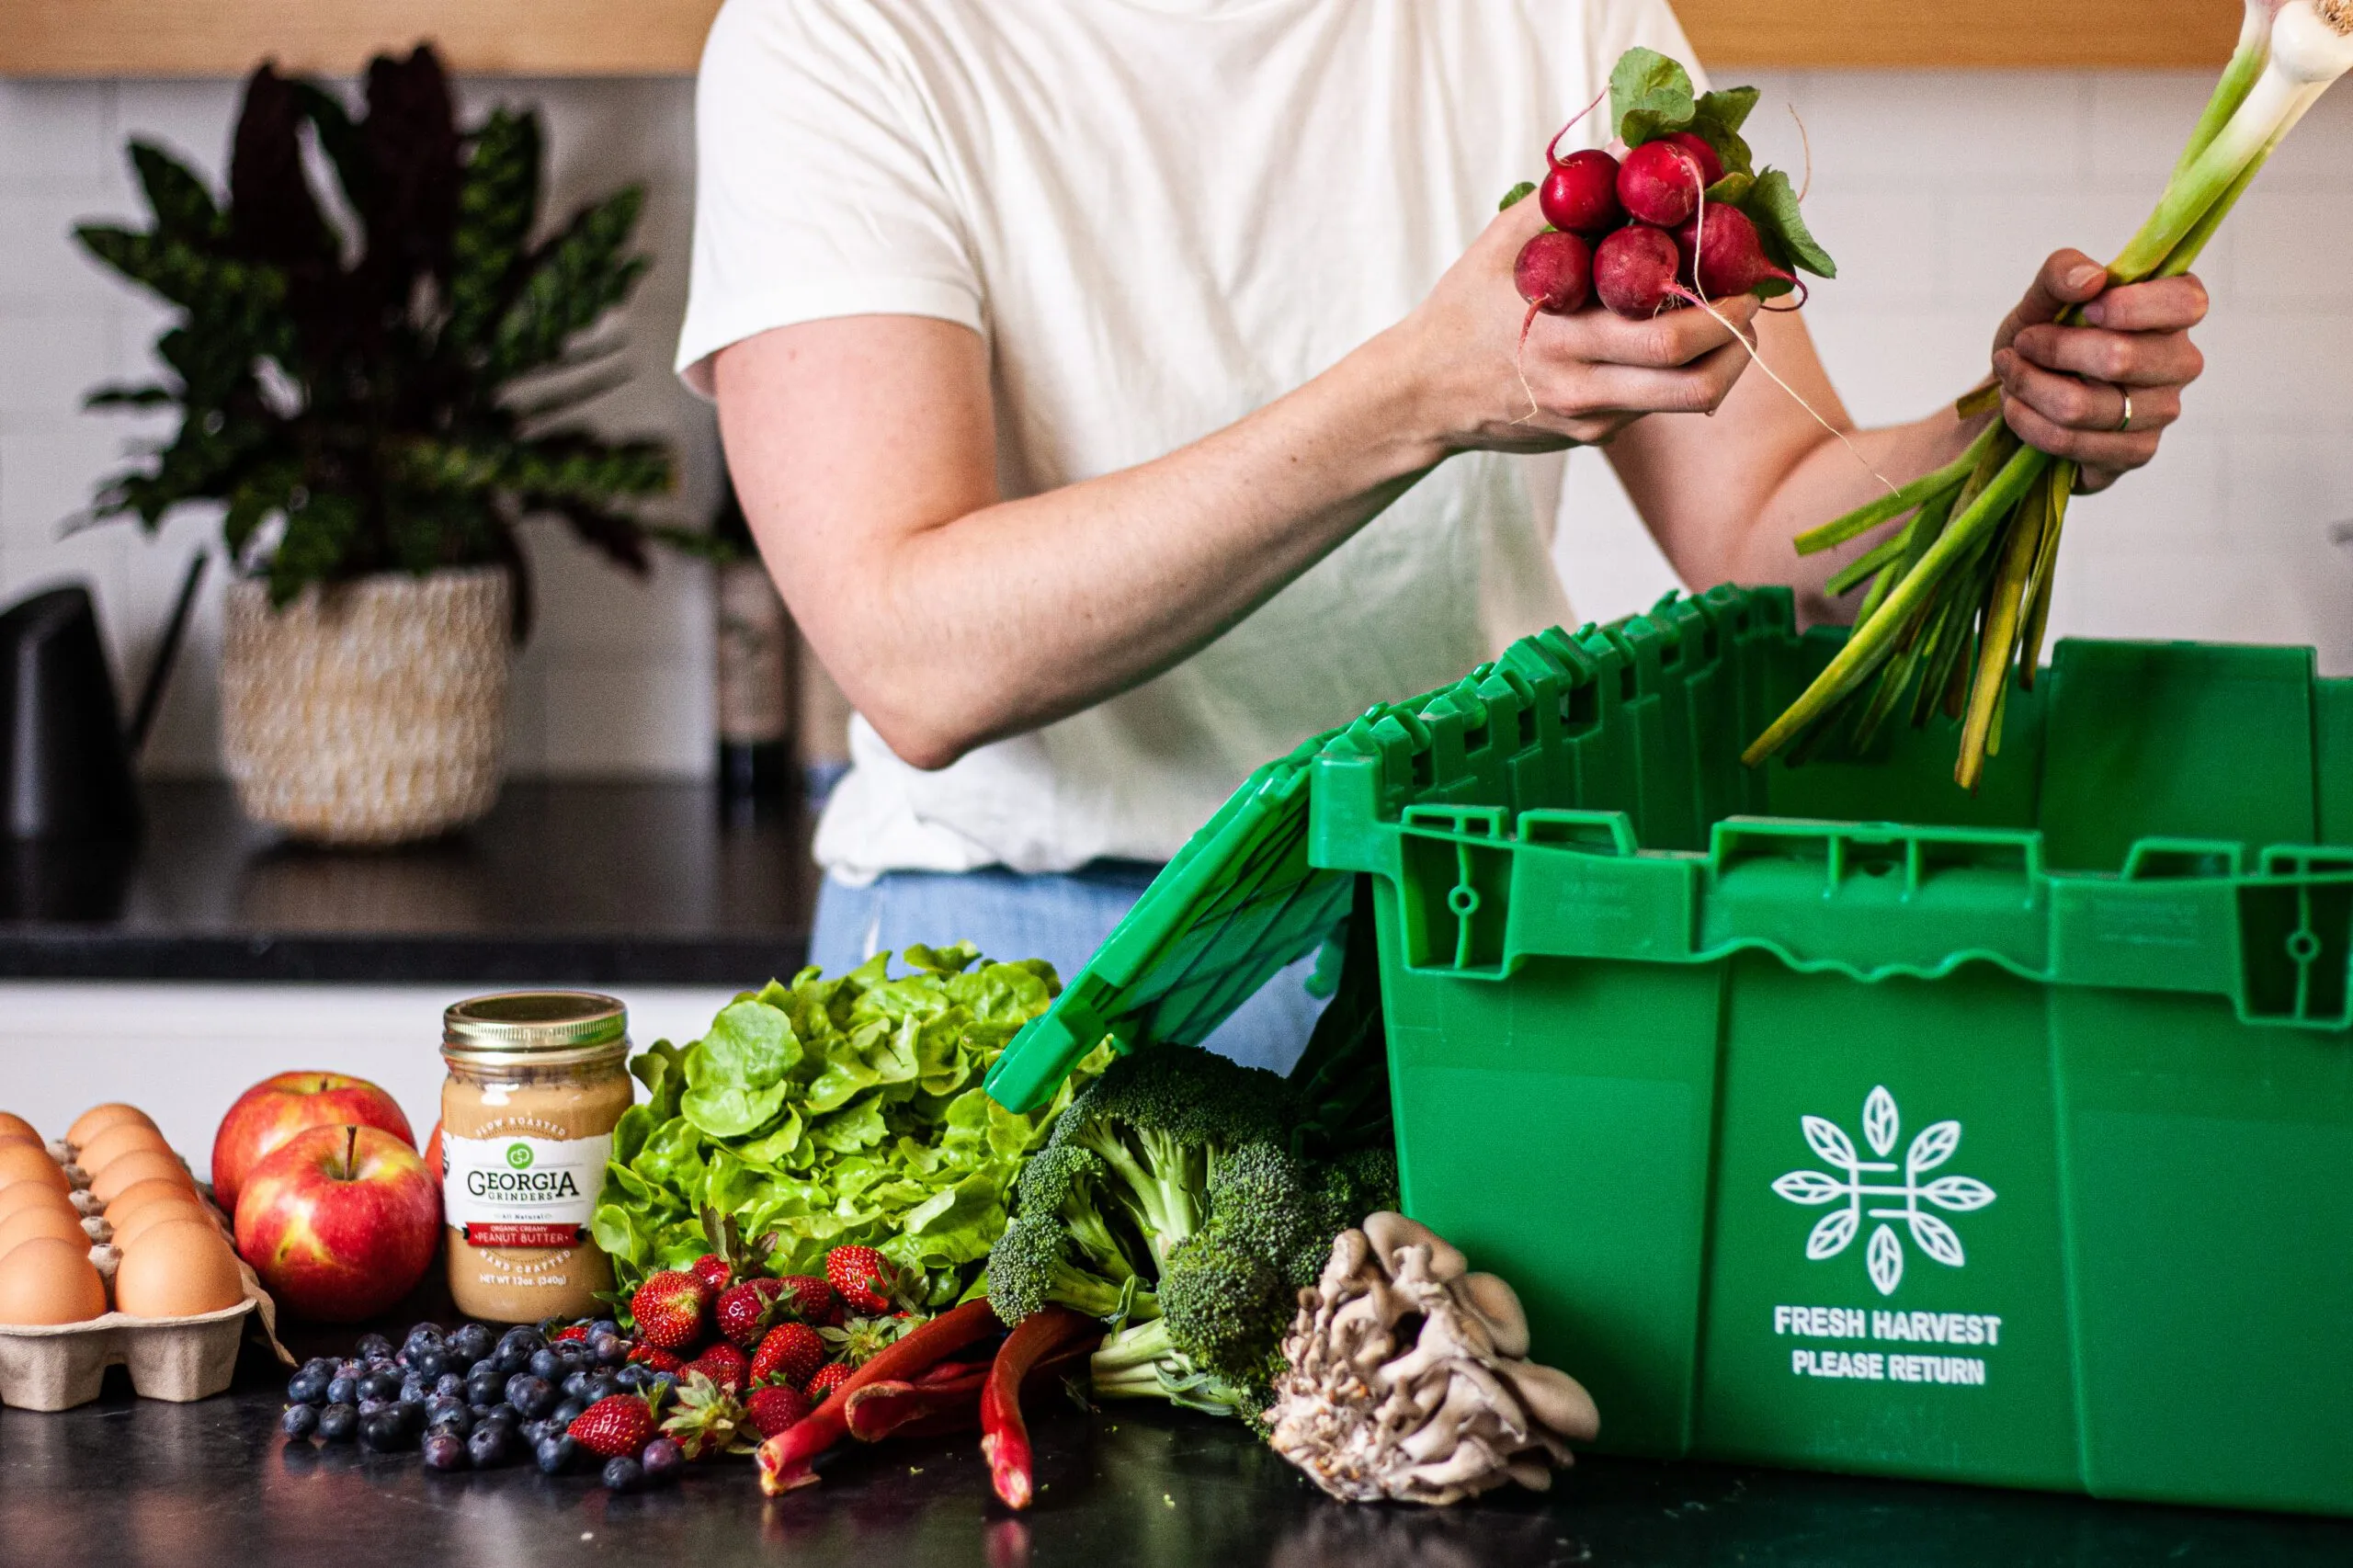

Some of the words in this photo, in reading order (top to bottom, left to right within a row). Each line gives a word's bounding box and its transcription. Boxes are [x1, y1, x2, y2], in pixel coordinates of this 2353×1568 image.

[475, 1118, 504, 1137] SLOW
[509, 1117, 566, 1136] ROASTED
[467, 1171, 579, 1196] GEORGIA
[487, 1191, 553, 1201] GRINDERS
[478, 1233, 517, 1244] PEANUT
[521, 1233, 563, 1244] BUTTER
[490, 1224, 518, 1233] ORGANIC
[480, 1249, 511, 1271] HAND
[516, 1250, 572, 1273] CRAFTED
[479, 1275, 495, 1284] NET
[496, 1276, 510, 1284] WT
[1774, 1305, 1865, 1338] FRESH
[1872, 1311, 2002, 1346] HARVEST
[1792, 1349, 1884, 1380] PLEASE
[1889, 1356, 1986, 1385] RETURN
